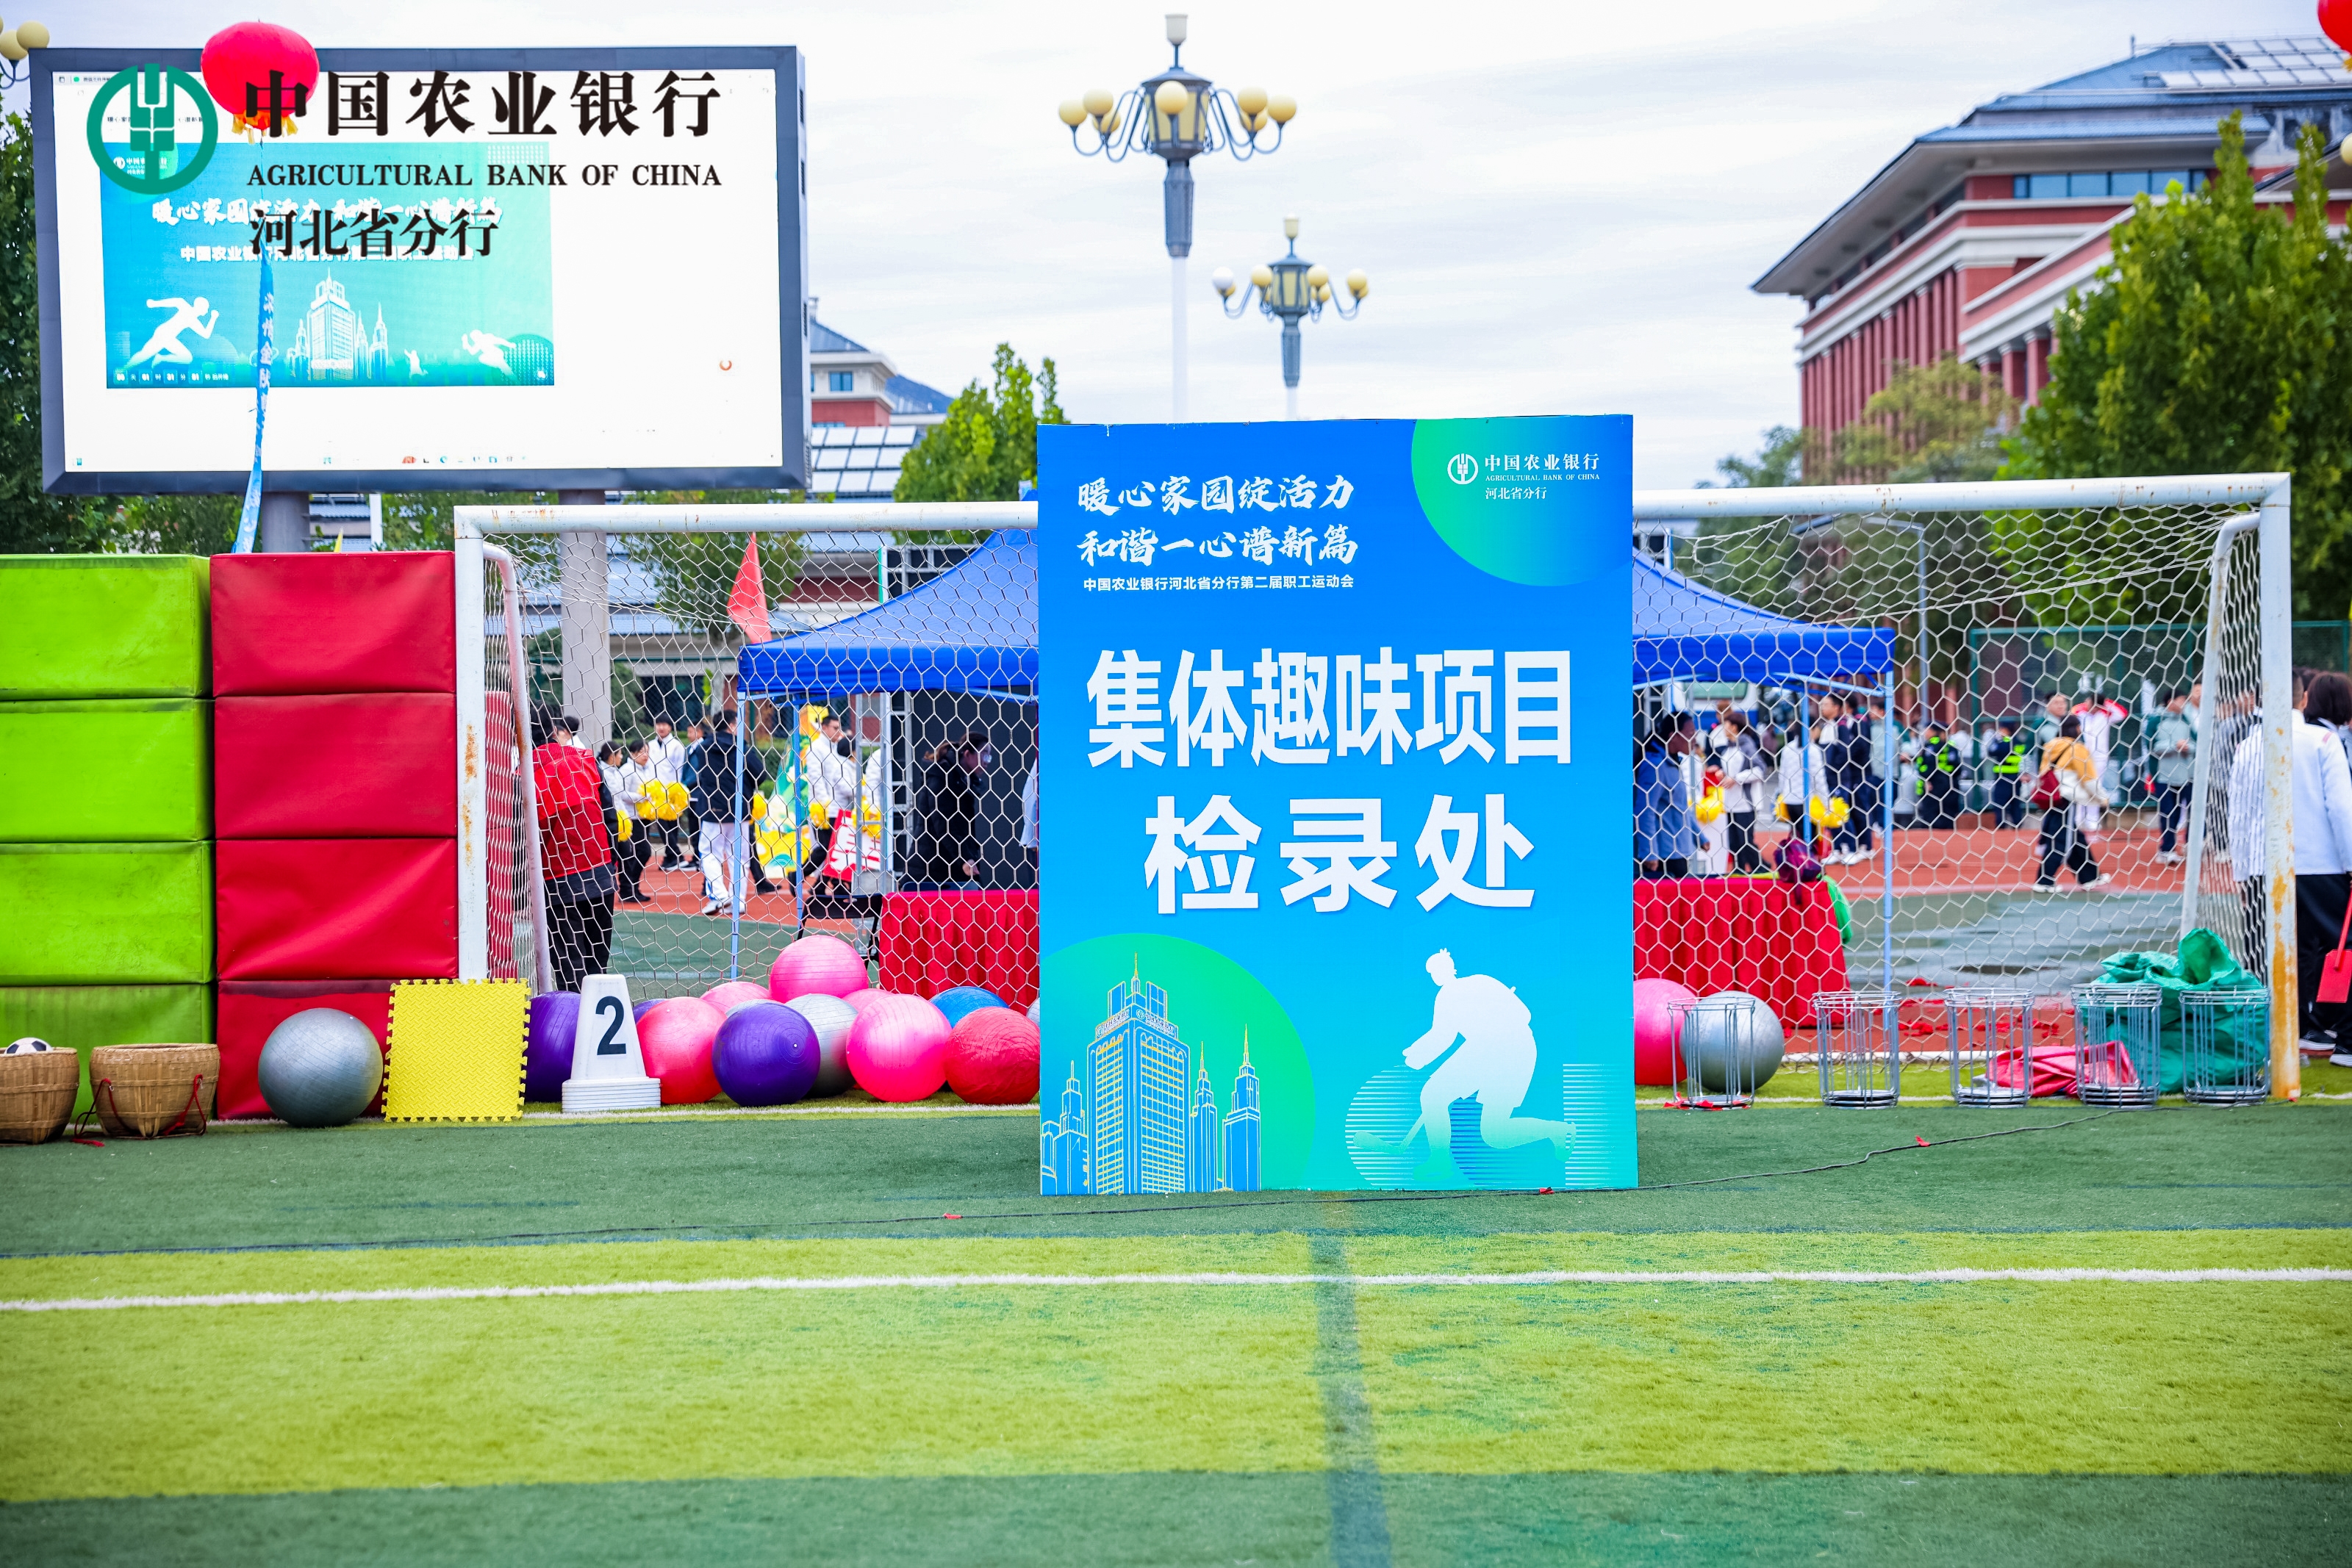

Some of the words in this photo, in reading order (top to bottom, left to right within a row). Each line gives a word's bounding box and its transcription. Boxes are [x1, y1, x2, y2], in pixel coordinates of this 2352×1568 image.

[1485, 453, 1599, 472] 中国农业银行
[1078, 474, 1355, 517] 暖心家园绽活力
[1485, 486, 1547, 500] 河北省分行
[1077, 523, 1359, 567] 和谐一心谱新篇
[1083, 574, 1354, 592] 中国农业银行河北省分行第二届职工运动会
[1086, 646, 1571, 769] 集体趣味项目
[1144, 794, 1535, 914] 检录处
[595, 996, 627, 1056] 2
